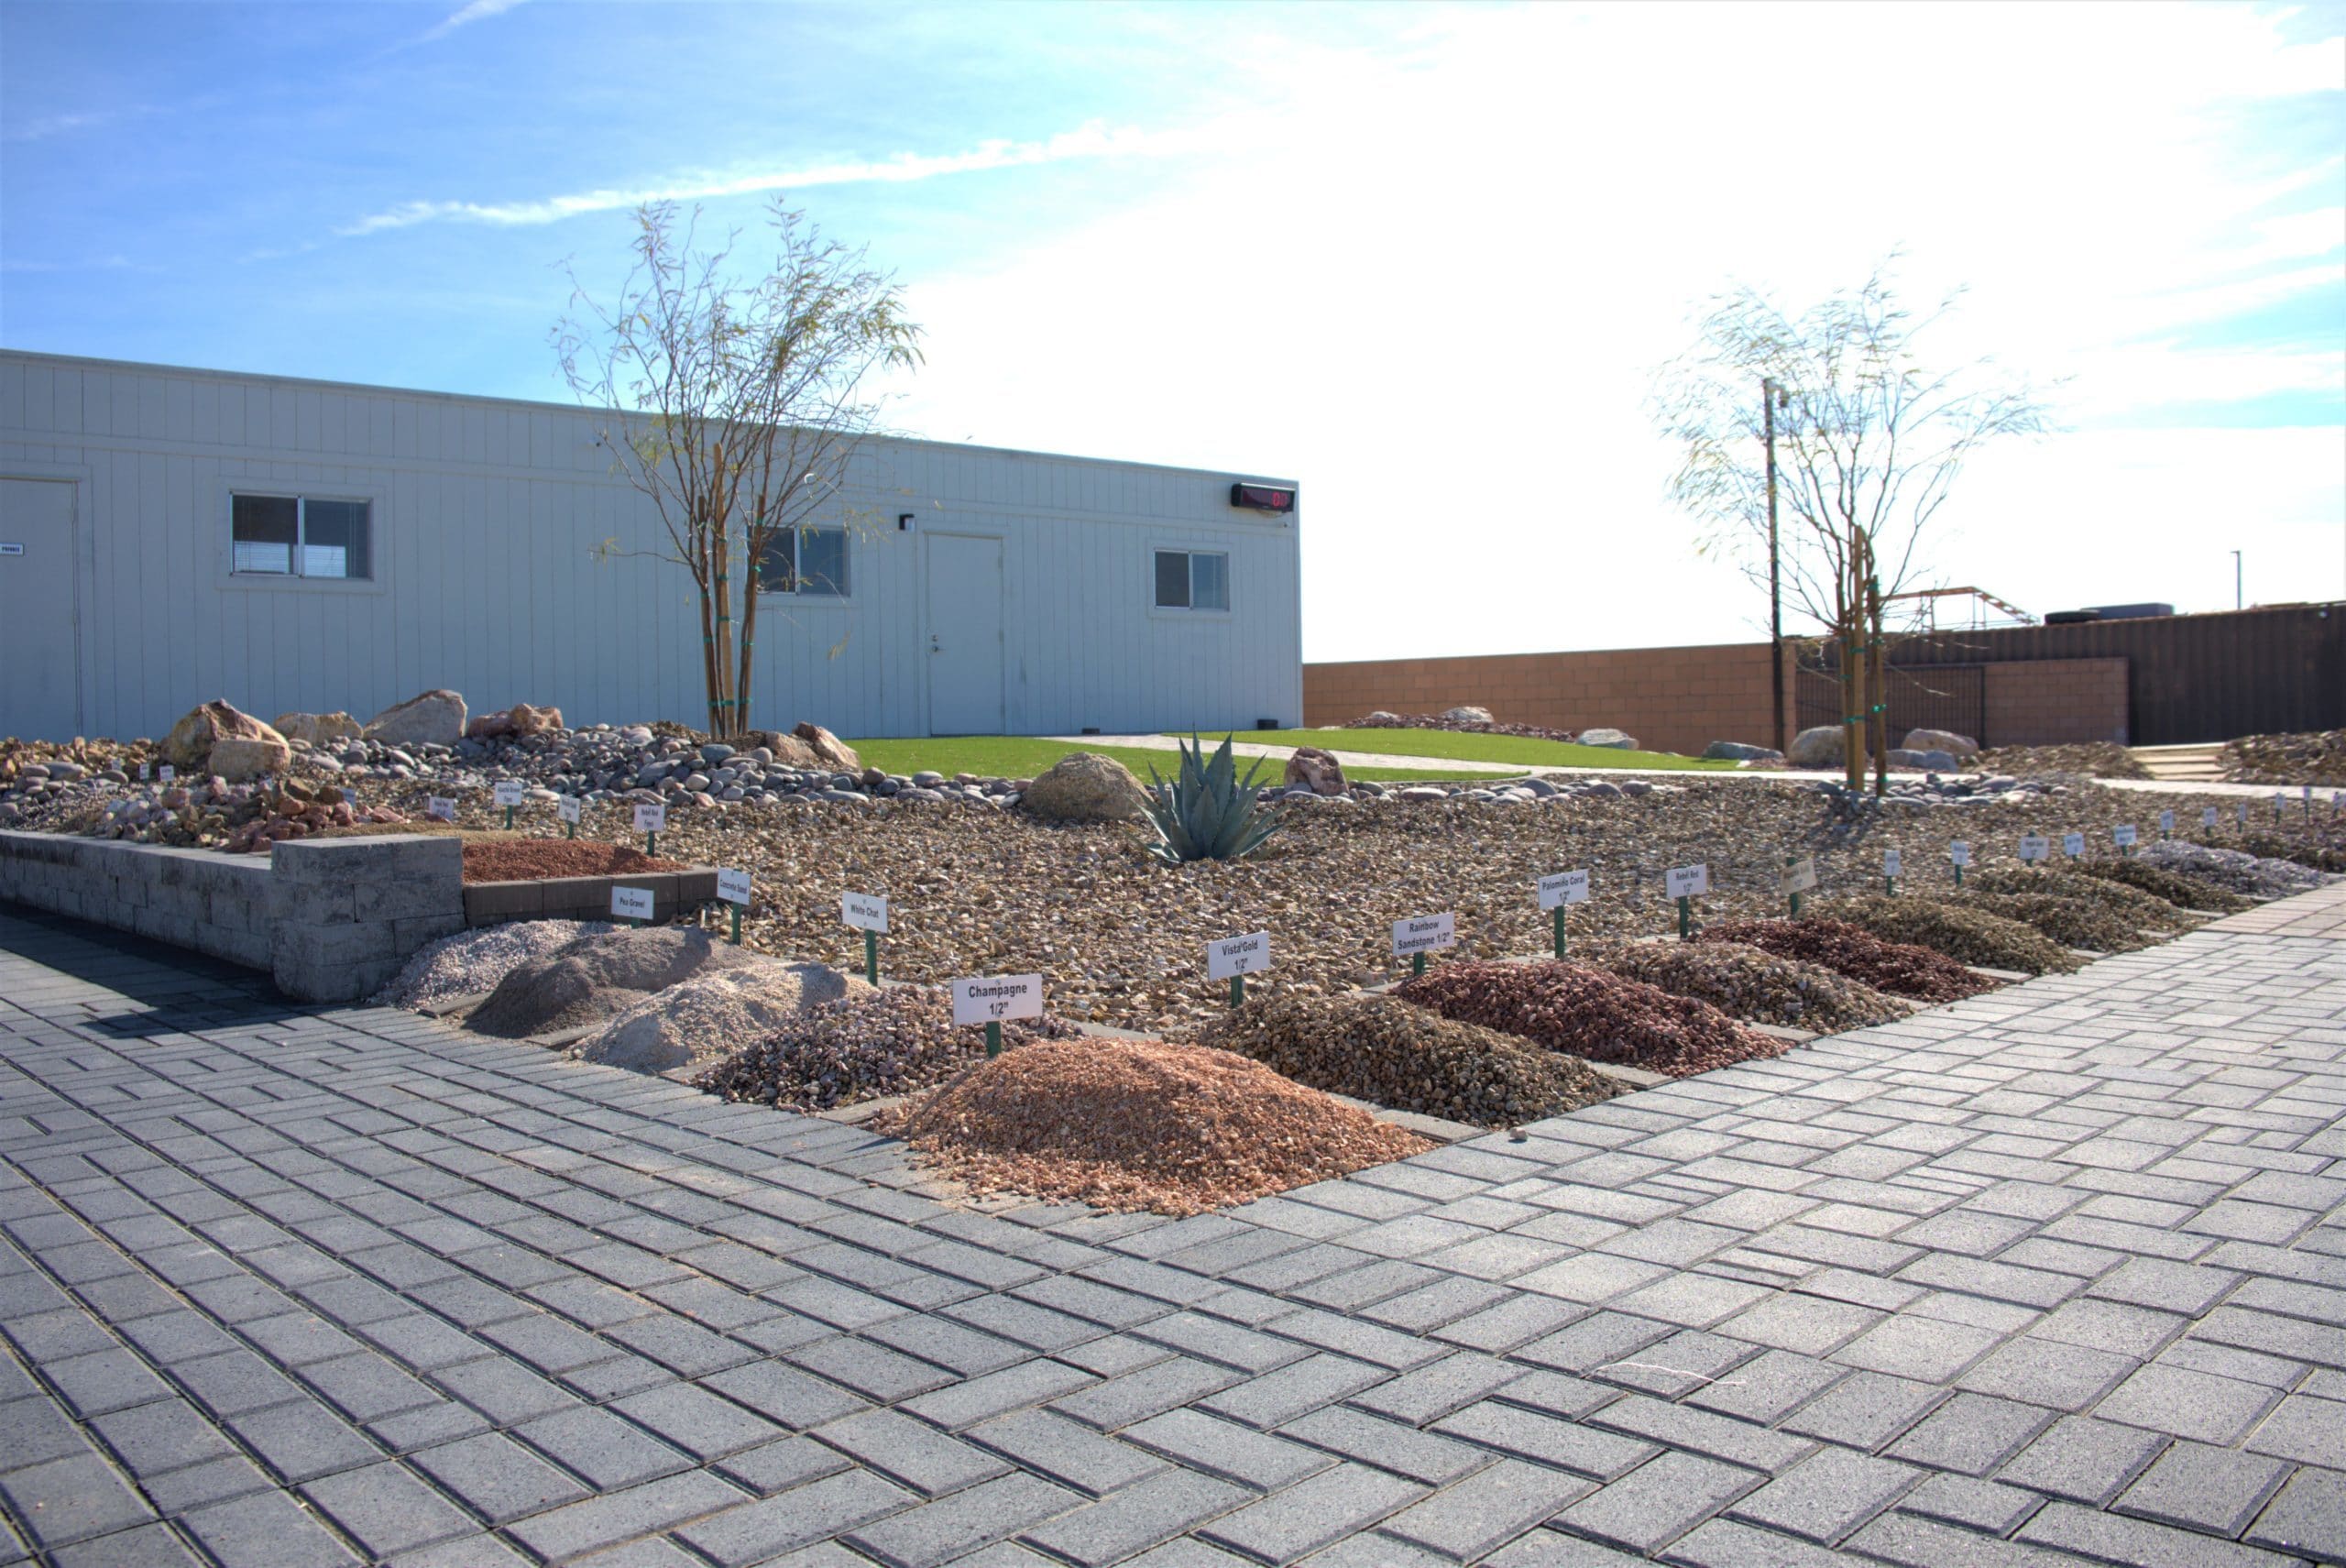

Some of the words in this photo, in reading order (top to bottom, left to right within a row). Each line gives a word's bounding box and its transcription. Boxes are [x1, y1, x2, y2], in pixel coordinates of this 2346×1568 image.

[719, 879, 736, 892] Concrete
[737, 883, 748, 894] Sand
[1542, 880, 1569, 891] Palomino
[1570, 873, 1584, 885] Coral
[619, 896, 629, 906] Pea
[630, 898, 645, 908] Gravel
[850, 903, 865, 915] White
[866, 906, 879, 918] Chat
[1409, 921, 1440, 933] Rainbow
[1398, 937, 1435, 949] Sandstone
[1437, 931, 1451, 943] 1/2"
[1222, 944, 1241, 956] Vista
[1243, 939, 1258, 952] Gold
[1234, 957, 1248, 970] 1/2"
[969, 984, 1027, 998] Champagne
[989, 1001, 1009, 1015] 1/2"
